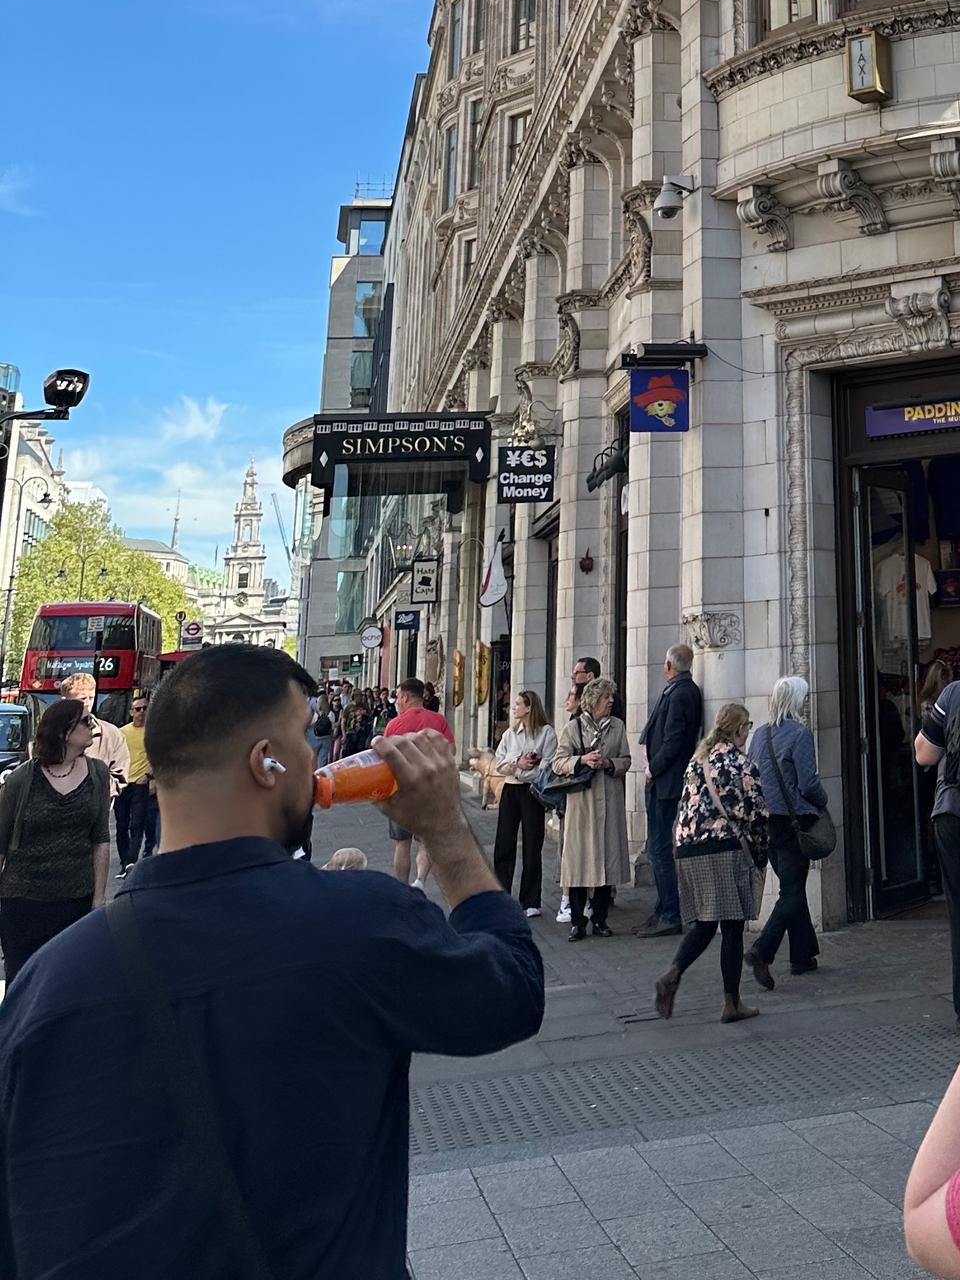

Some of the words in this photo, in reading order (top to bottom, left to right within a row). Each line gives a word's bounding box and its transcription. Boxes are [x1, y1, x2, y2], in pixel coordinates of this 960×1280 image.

[857, 40, 866, 87] TAXI
[342, 436, 466, 455] SIMPSON'S
[500, 472, 553, 486] Change
[503, 485, 549, 499] Money
[416, 567, 435, 575] Hats
[415, 586, 434, 595] Caps
